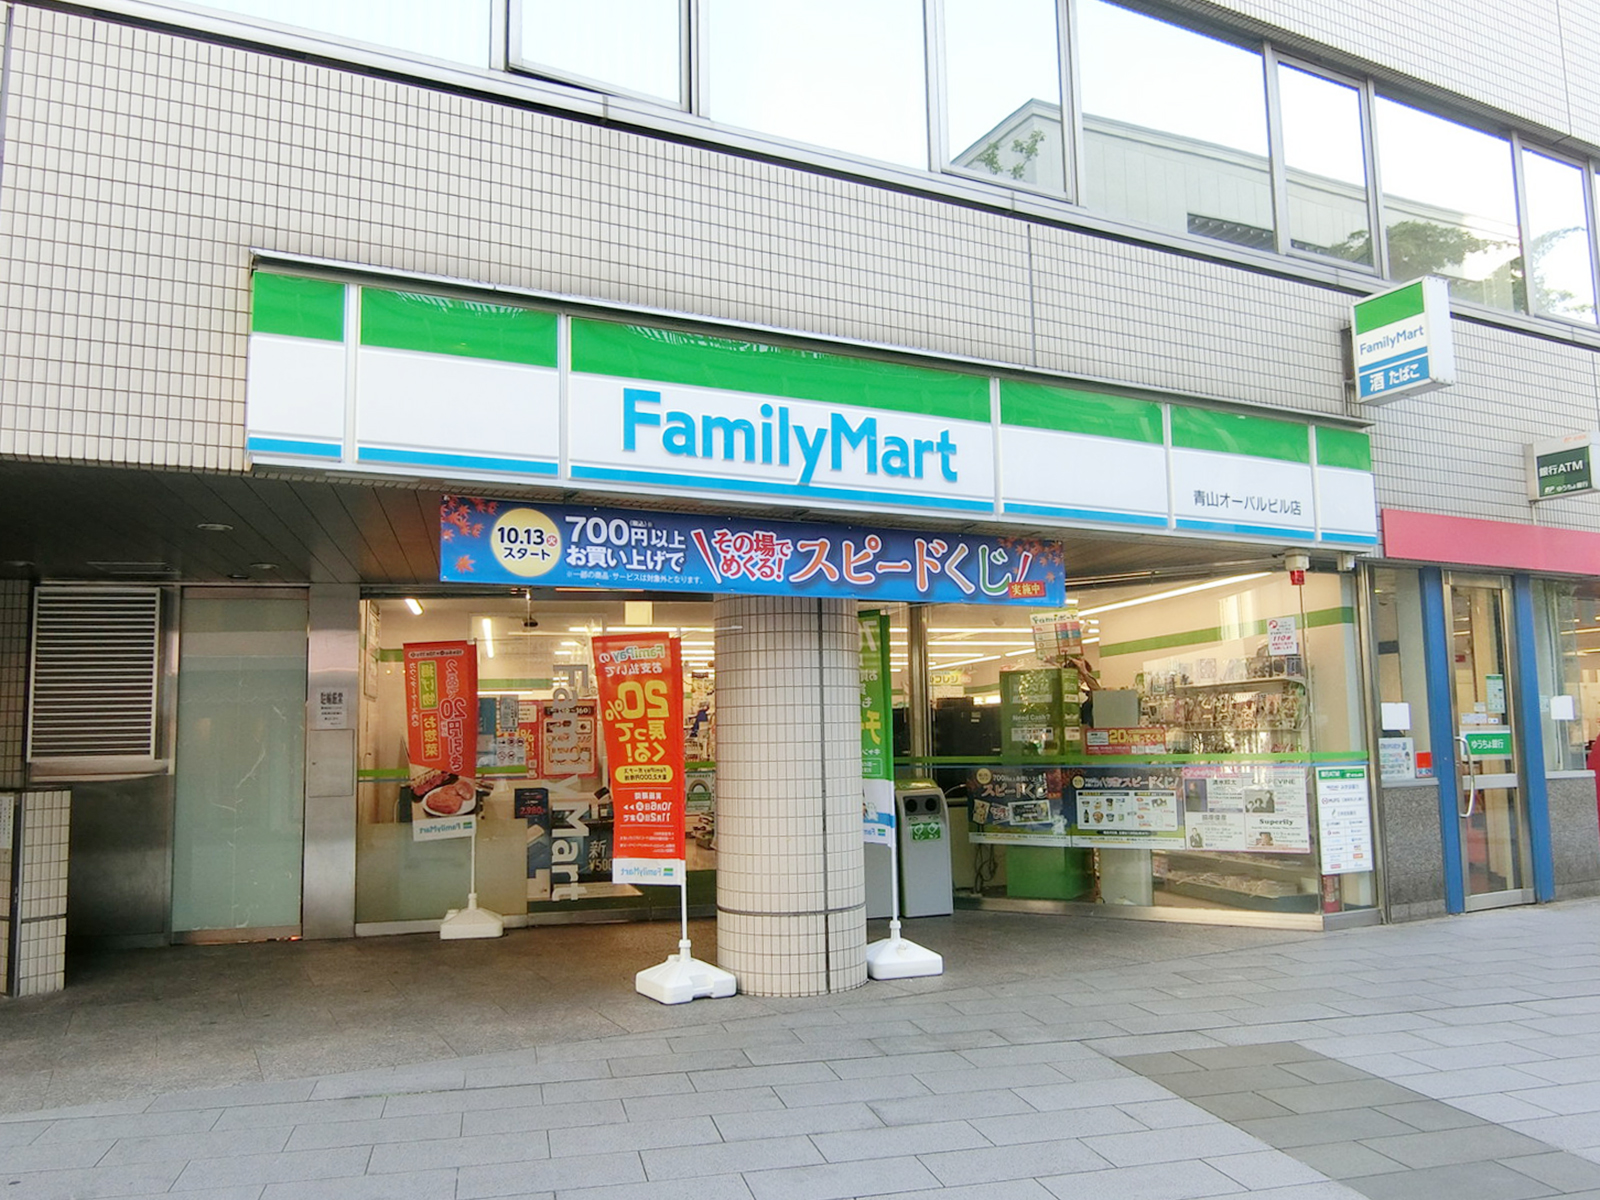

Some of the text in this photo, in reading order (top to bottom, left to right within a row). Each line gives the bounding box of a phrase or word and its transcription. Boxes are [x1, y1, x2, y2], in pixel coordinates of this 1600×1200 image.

[1360, 326, 1424, 355] FamilyMart
[1370, 363, 1420, 391] 酒 たばこ
[622, 388, 957, 486] FamilyMart
[1539, 460, 1583, 477] 銀行ATM
[1193, 490, 1301, 515] 青山オーバルビル店
[565, 516, 687, 549] 700円以上
[714, 532, 791, 557] その場で
[503, 547, 551, 561] スタート
[565, 545, 685, 572] お買い上げで
[1011, 583, 1041, 595] 実施中
[1470, 739, 1504, 749] ゆうちょ銀行
